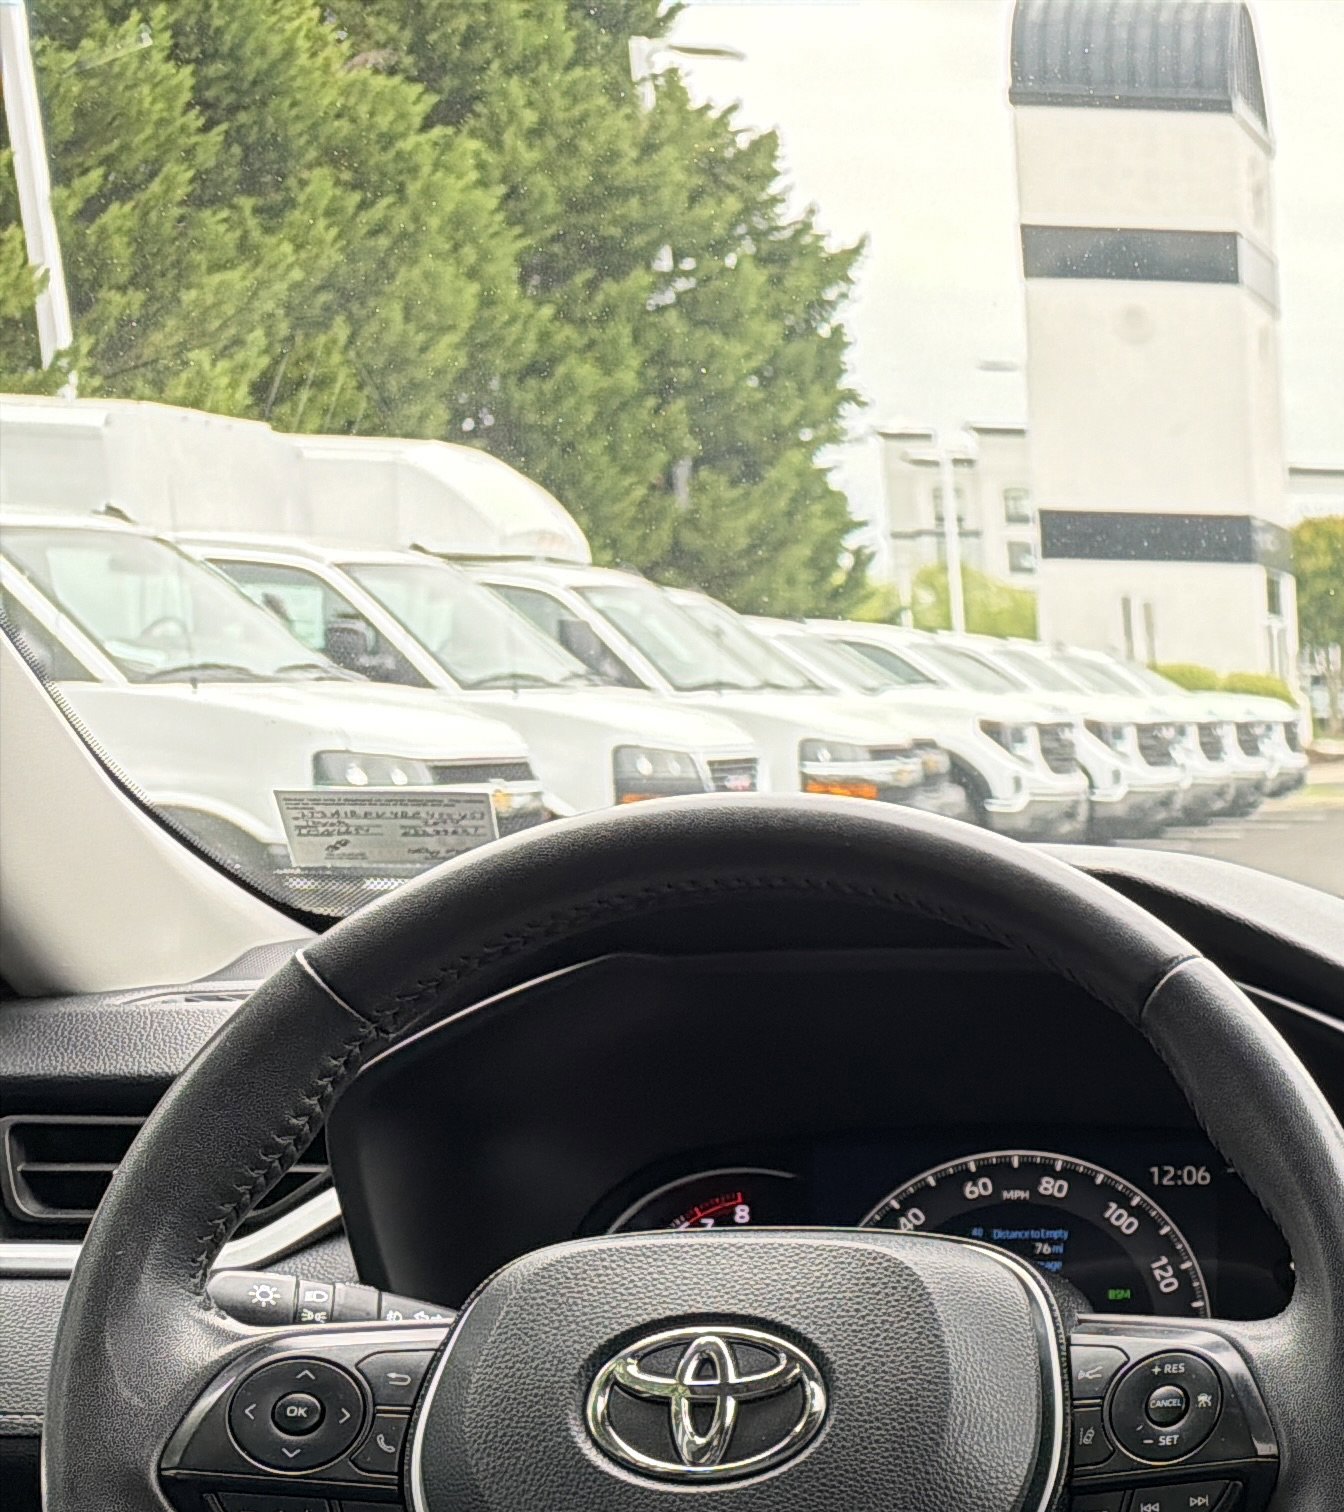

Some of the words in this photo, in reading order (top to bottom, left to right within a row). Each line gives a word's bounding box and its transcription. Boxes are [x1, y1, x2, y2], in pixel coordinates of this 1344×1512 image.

[1150, 1166, 1210, 1186] 12:06
[963, 1177, 993, 1199] 60
[1002, 1190, 1029, 1200] MPH
[1037, 1177, 1068, 1198] 80
[734, 1204, 750, 1224] 8
[897, 1208, 926, 1231] 40
[1102, 1202, 1139, 1236] 100
[992, 1229, 1029, 1240] Distance
[1040, 1229, 1069, 1241] Empty
[1033, 1242, 1051, 1255] 76
[1051, 1242, 1064, 1254] mi
[1150, 1256, 1179, 1293] 120
[1164, 1363, 1185, 1374] RES
[1149, 1398, 1182, 1408] CANCEL
[286, 1406, 307, 1417] OK
[1158, 1435, 1179, 1446] SET
